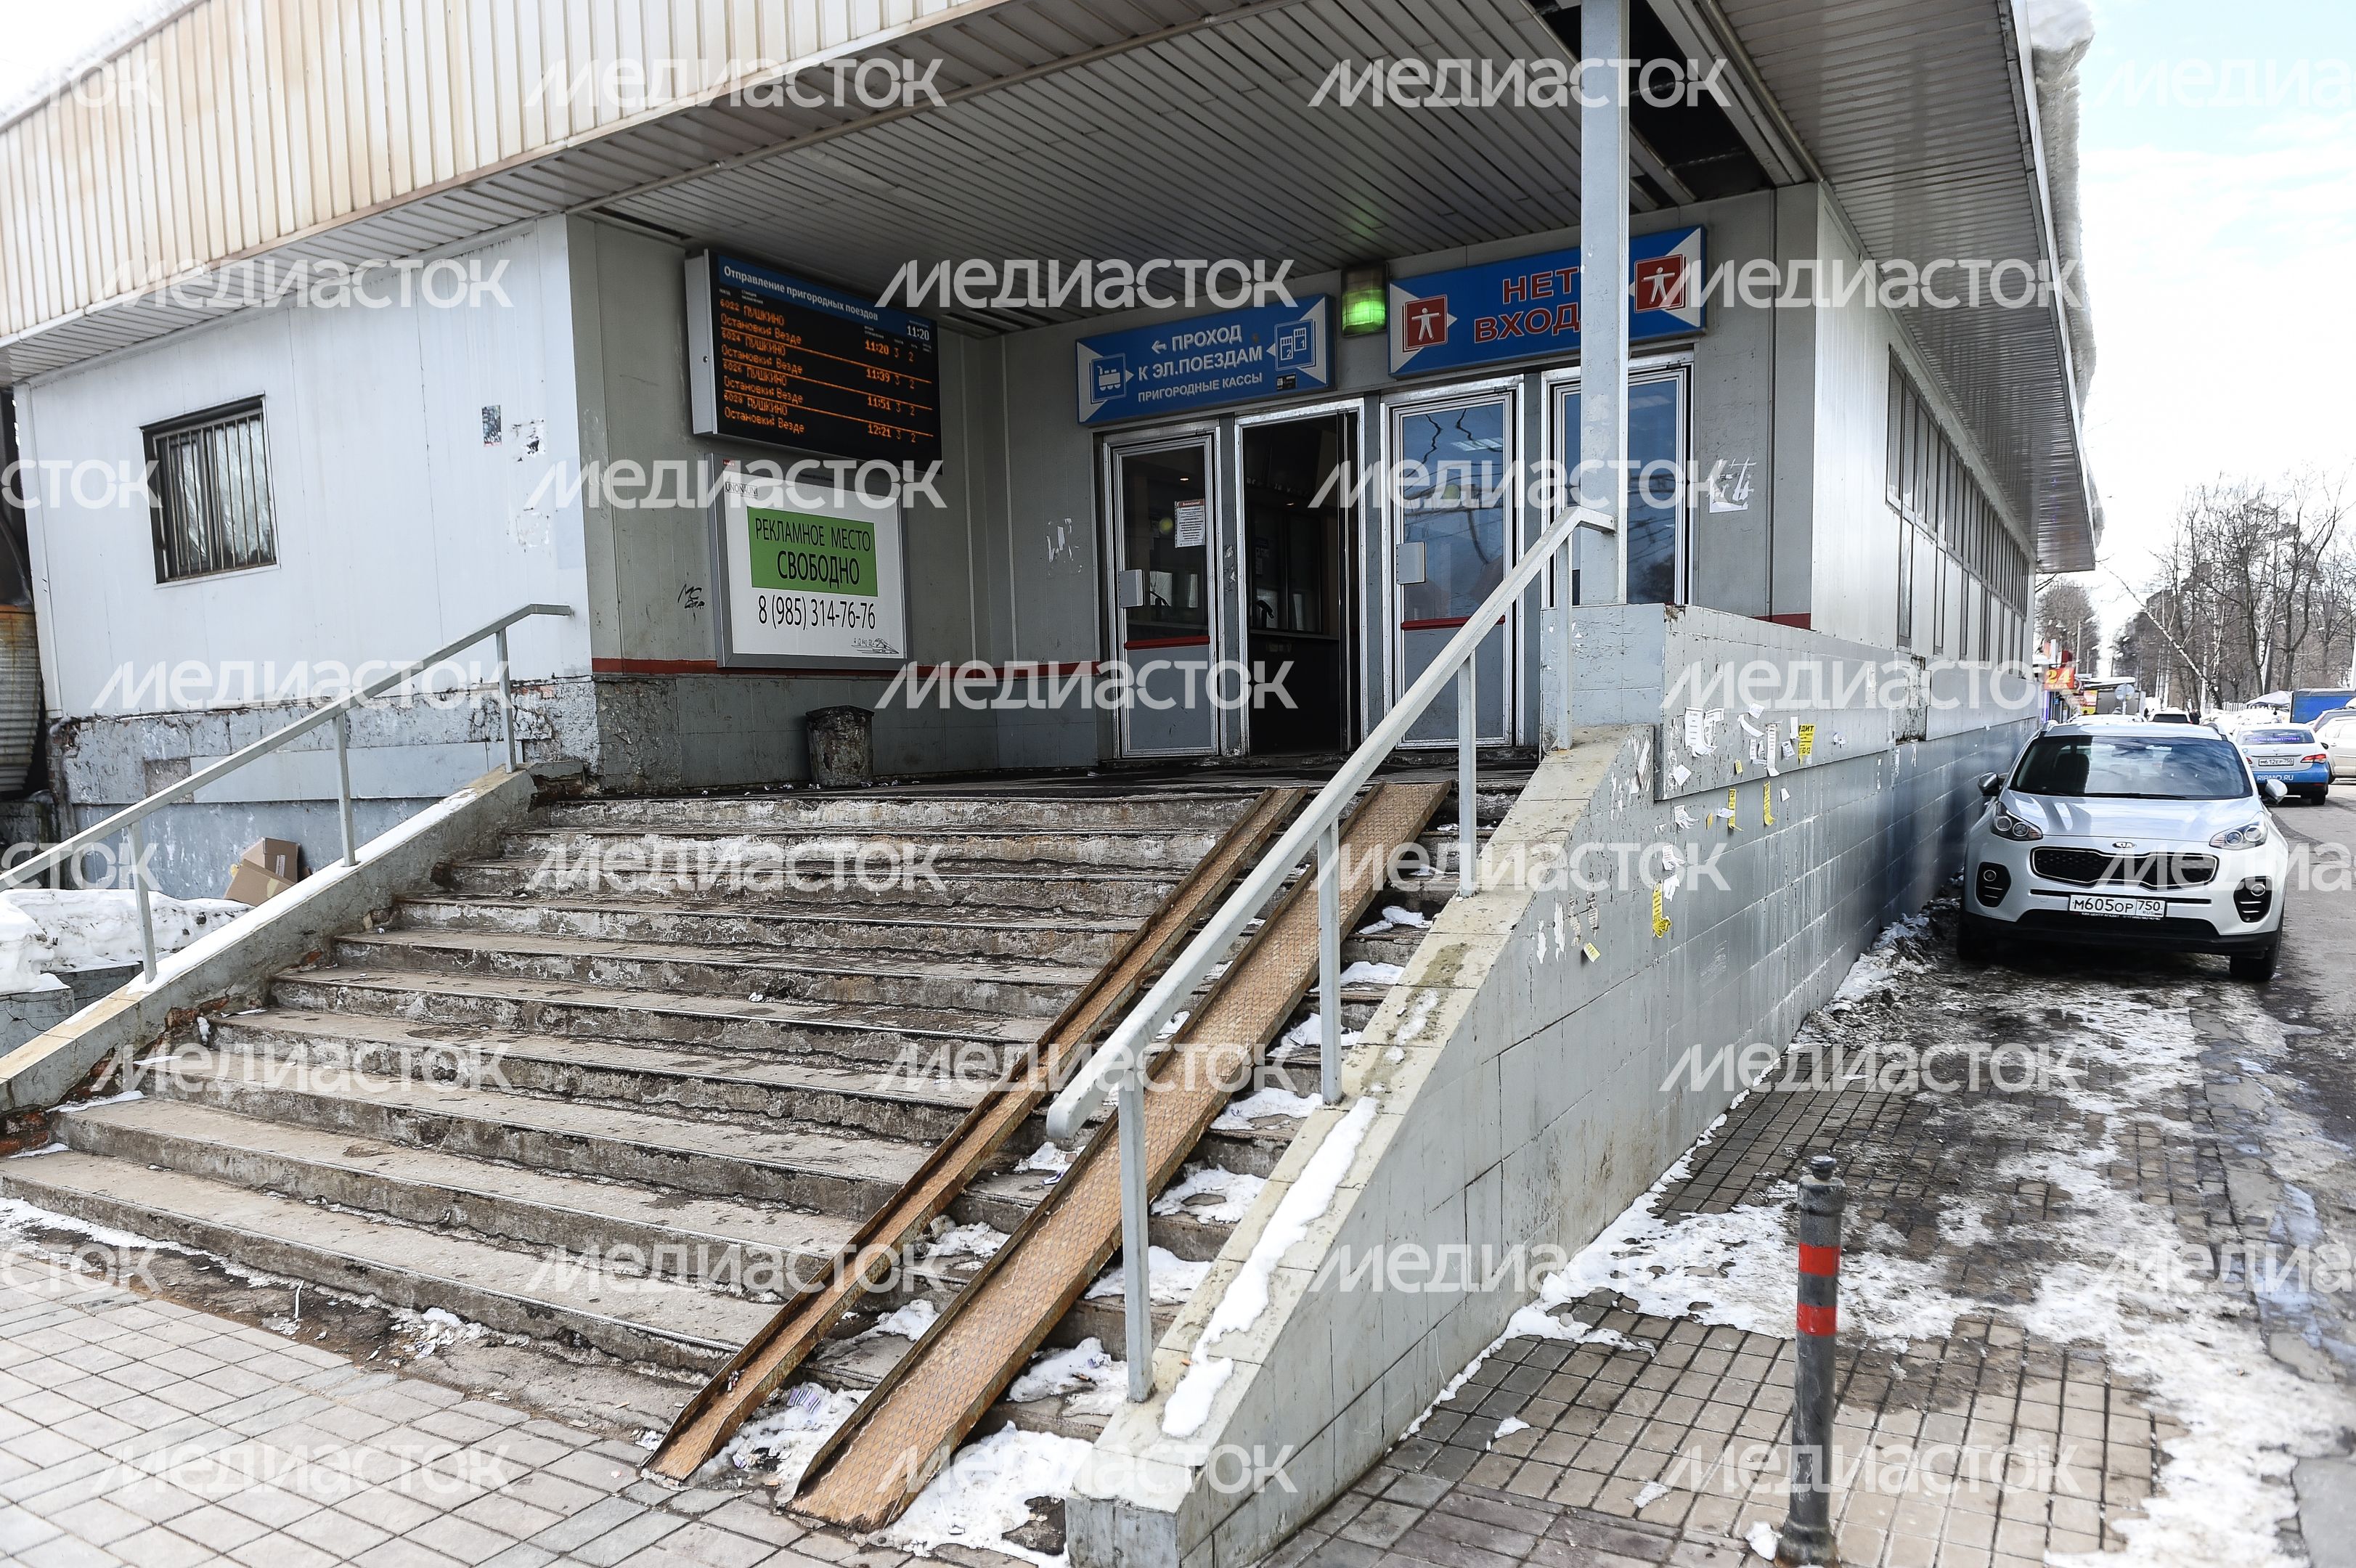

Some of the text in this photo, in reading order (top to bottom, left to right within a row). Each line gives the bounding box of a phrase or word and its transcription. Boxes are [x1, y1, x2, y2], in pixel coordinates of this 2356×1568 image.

[724, 266, 785, 293] Отправление
[786, 286, 844, 311] пригородных
[845, 304, 879, 320] поездов
[1502, 266, 1579, 305] НЕТ
[743, 305, 785, 326] ПУШКИНО
[865, 339, 889, 356] 11:20
[894, 348, 900, 358] 3
[908, 351, 914, 362] 2
[774, 327, 802, 345] Везде
[907, 324, 930, 340] 11:20
[1172, 324, 1242, 352] ПРОХОД
[1474, 302, 1581, 343] ВХОД
[745, 335, 786, 356] ПУШКИНО
[866, 368, 890, 383] 11:39
[894, 375, 900, 385] 3
[909, 379, 915, 390] 2
[776, 357, 802, 375] Везде
[1138, 346, 1263, 381] К ЭЛ.ПОЕЗДАМ
[746, 366, 787, 386] ПУШКИНО
[868, 394, 891, 410] 11:51
[896, 401, 901, 412] 3
[910, 407, 915, 416] 2
[776, 388, 803, 404] Везде
[1138, 372, 1263, 402] ПРИГОРОДНЫЕ КАССЫ
[725, 407, 804, 434] Остановки: Везде
[747, 397, 788, 416] ПУШКИНО
[868, 423, 892, 438] 12:21
[897, 428, 901, 440] 3
[910, 433, 916, 443] 2
[755, 518, 871, 552] РЕКЛАМНОЕ МЕСТО
[777, 550, 860, 589] СВОБОДНО
[758, 595, 876, 631] 8 (985) 314-76-76
[2046, 669, 2071, 684] 24
[2137, 899, 2161, 911] 750
